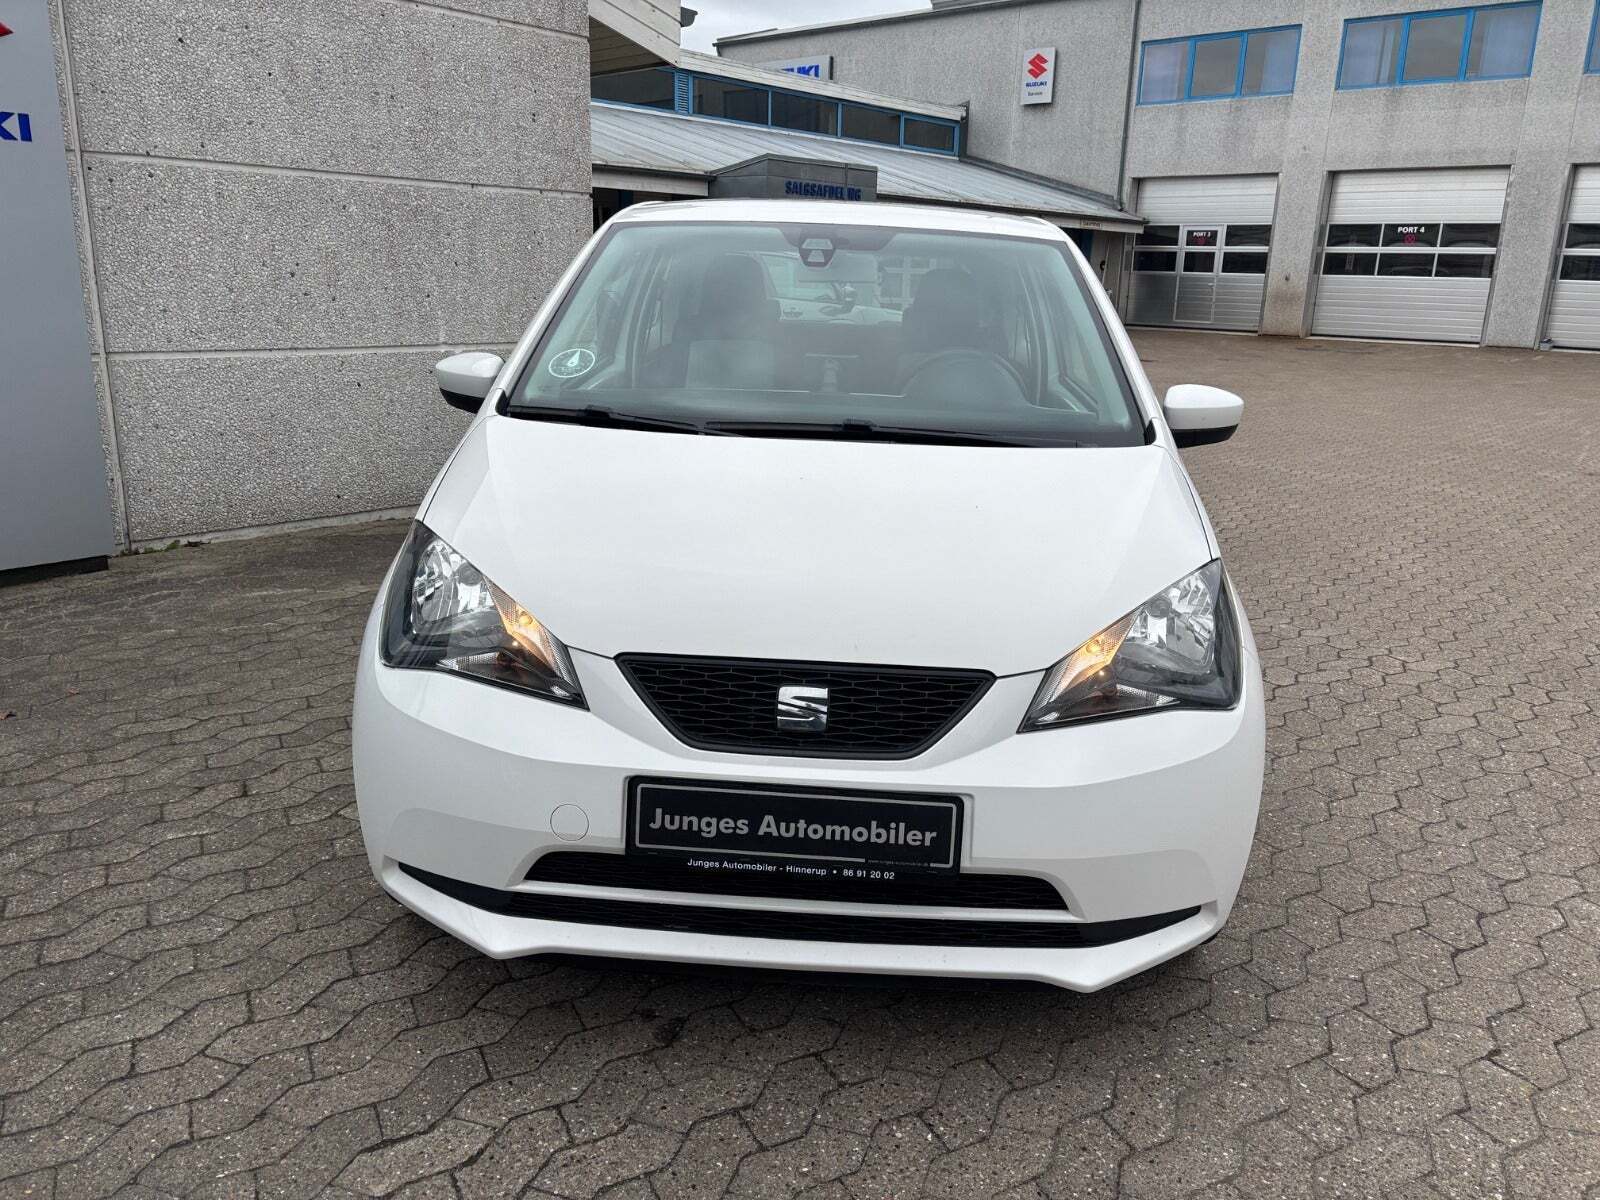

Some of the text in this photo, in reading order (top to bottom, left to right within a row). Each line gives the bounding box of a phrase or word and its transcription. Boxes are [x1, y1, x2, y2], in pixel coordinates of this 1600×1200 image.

[649, 807, 938, 847] Junges Automobiler
[687, 858, 720, 869] Junges
[722, 860, 777, 872] Automobiler
[786, 865, 827, 876] Hinnerup
[842, 868, 854, 877] 86
[856, 869, 867, 878] 91
[870, 870, 881, 879] 20
[883, 871, 895, 880] 02
